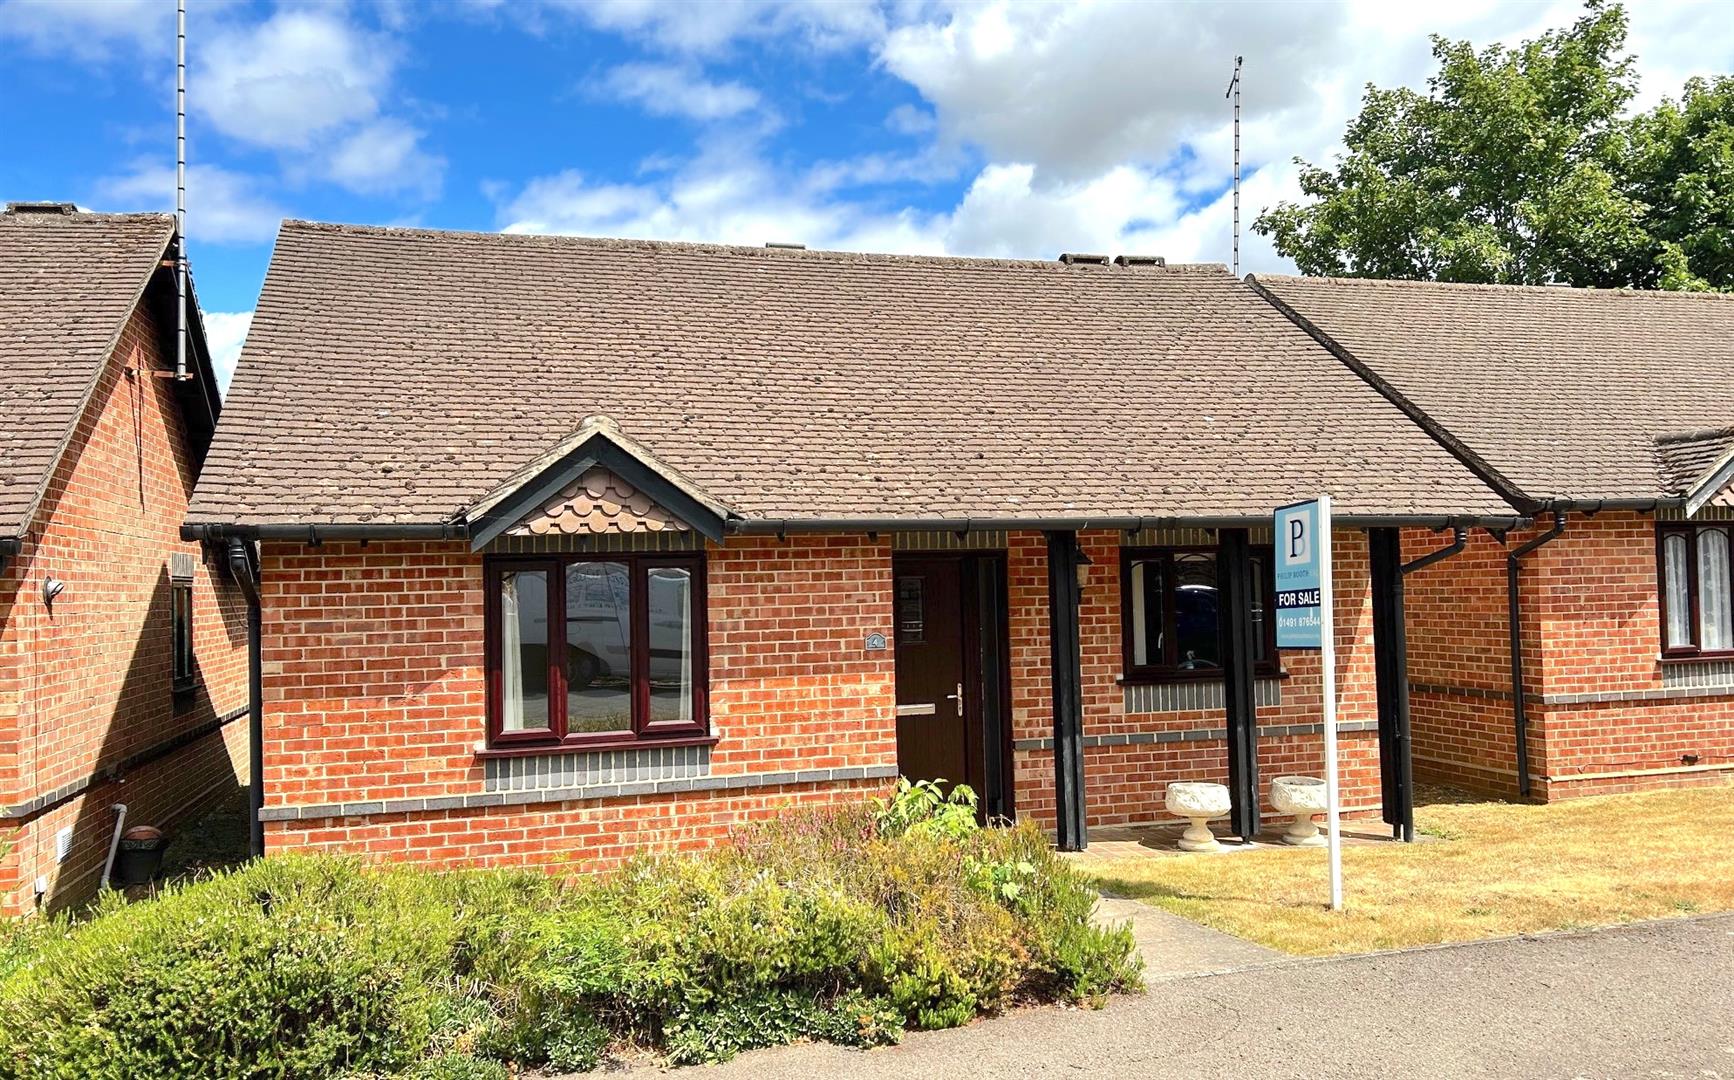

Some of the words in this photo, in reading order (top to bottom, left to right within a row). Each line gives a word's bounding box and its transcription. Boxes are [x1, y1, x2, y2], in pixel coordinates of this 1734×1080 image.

[1279, 593, 1296, 606] FOR
[1298, 591, 1320, 605] SALE
[1278, 617, 1297, 628] 01491
